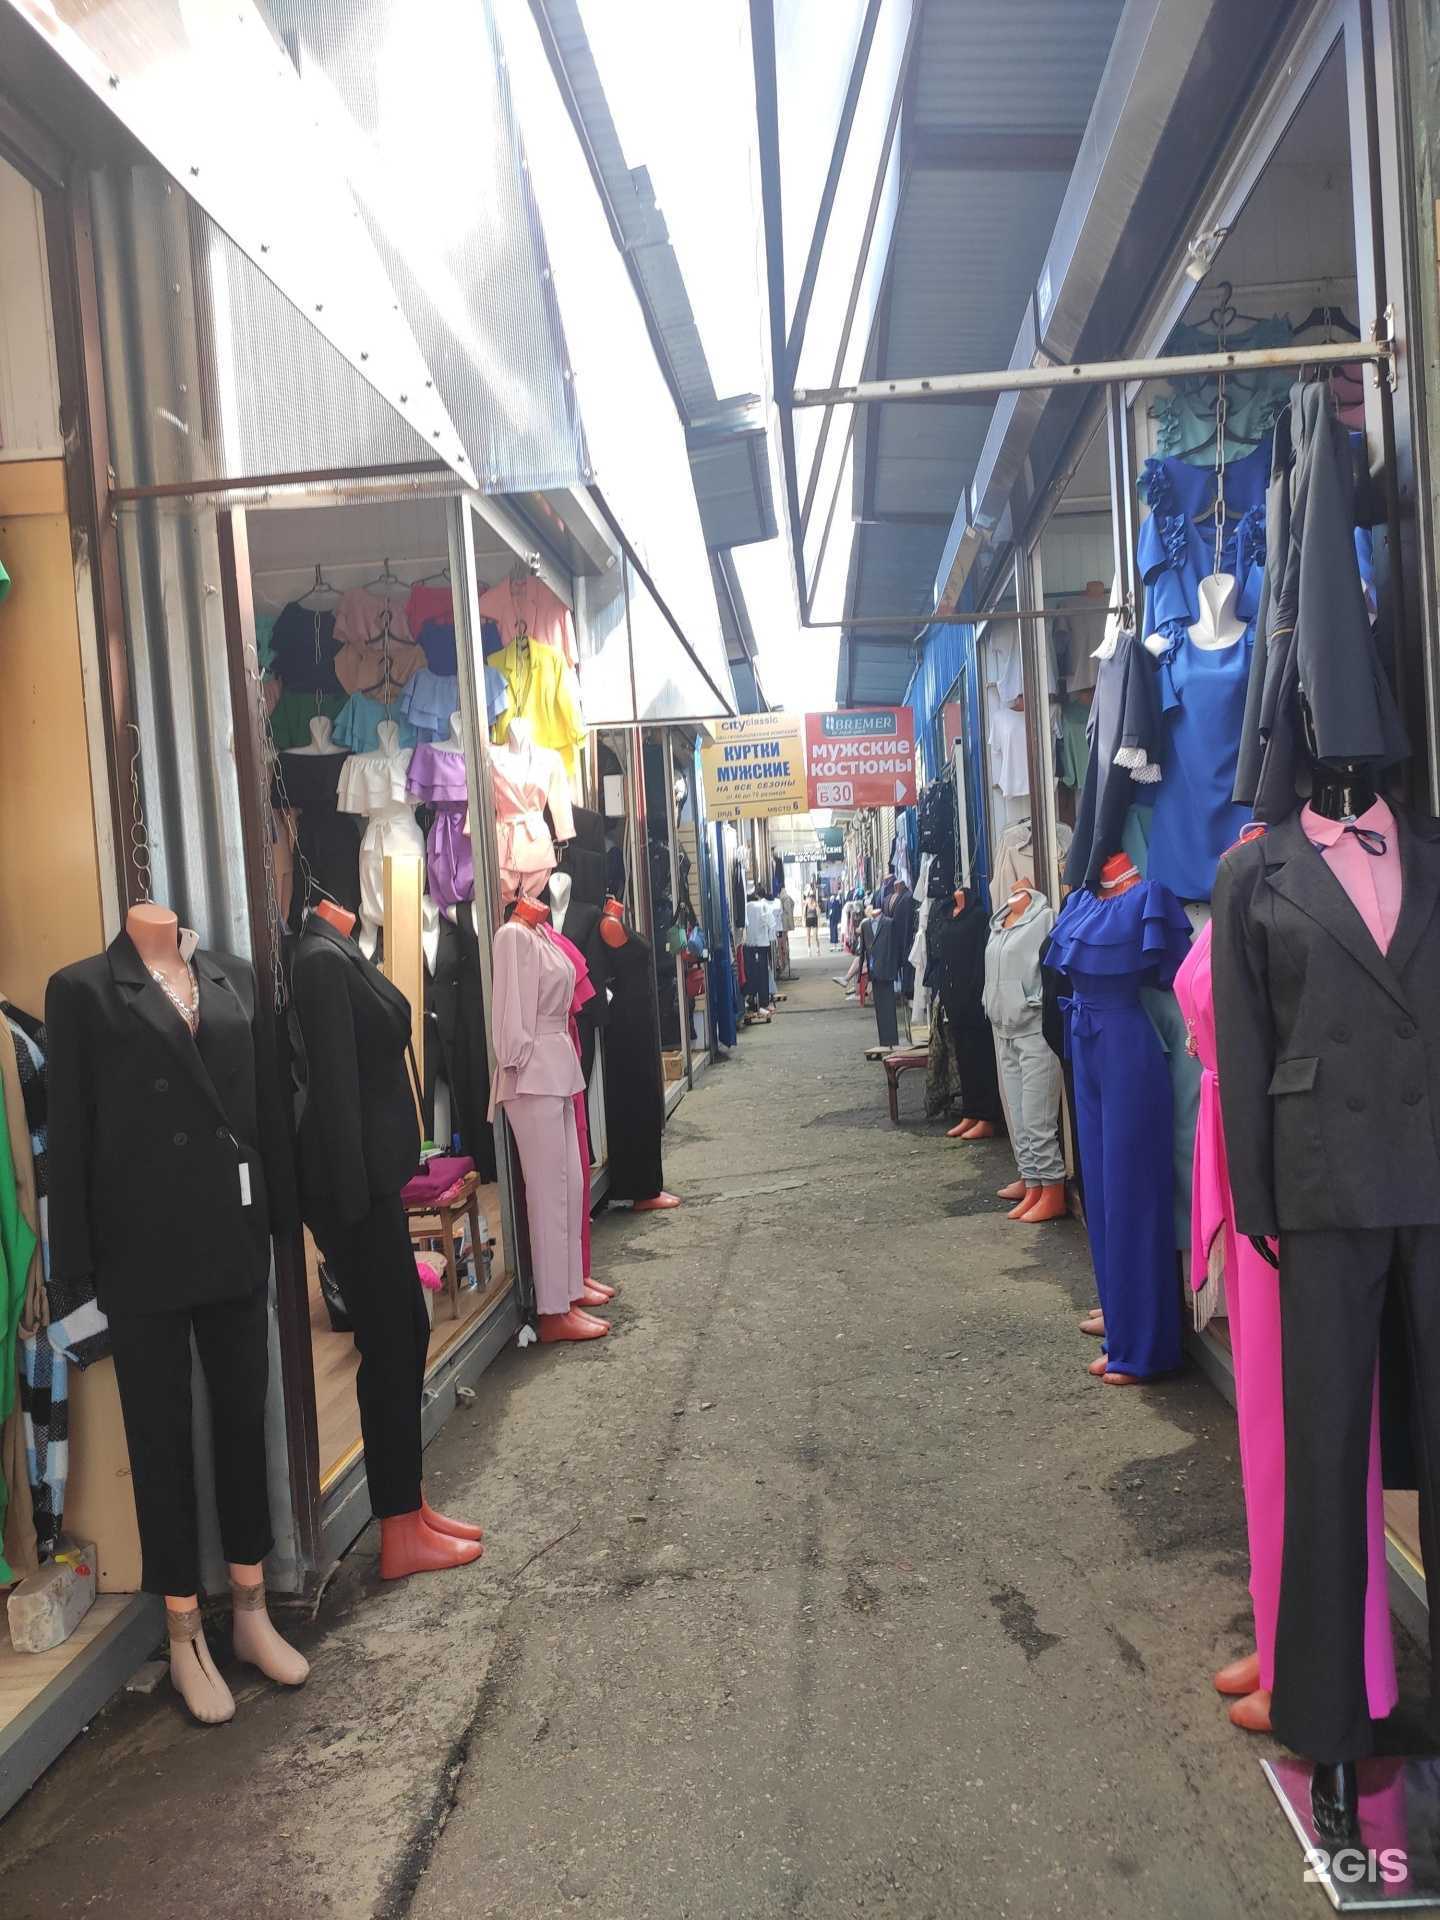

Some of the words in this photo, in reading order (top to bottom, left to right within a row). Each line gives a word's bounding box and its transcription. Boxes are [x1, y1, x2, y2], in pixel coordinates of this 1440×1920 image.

[724, 742, 780, 761] КУРТКИ
[717, 762, 791, 782] МУЖСКИЕ
[716, 785, 729, 793] НА
[734, 783, 752, 791] ВСЕ
[757, 780, 796, 790] СЕЗОНЫ
